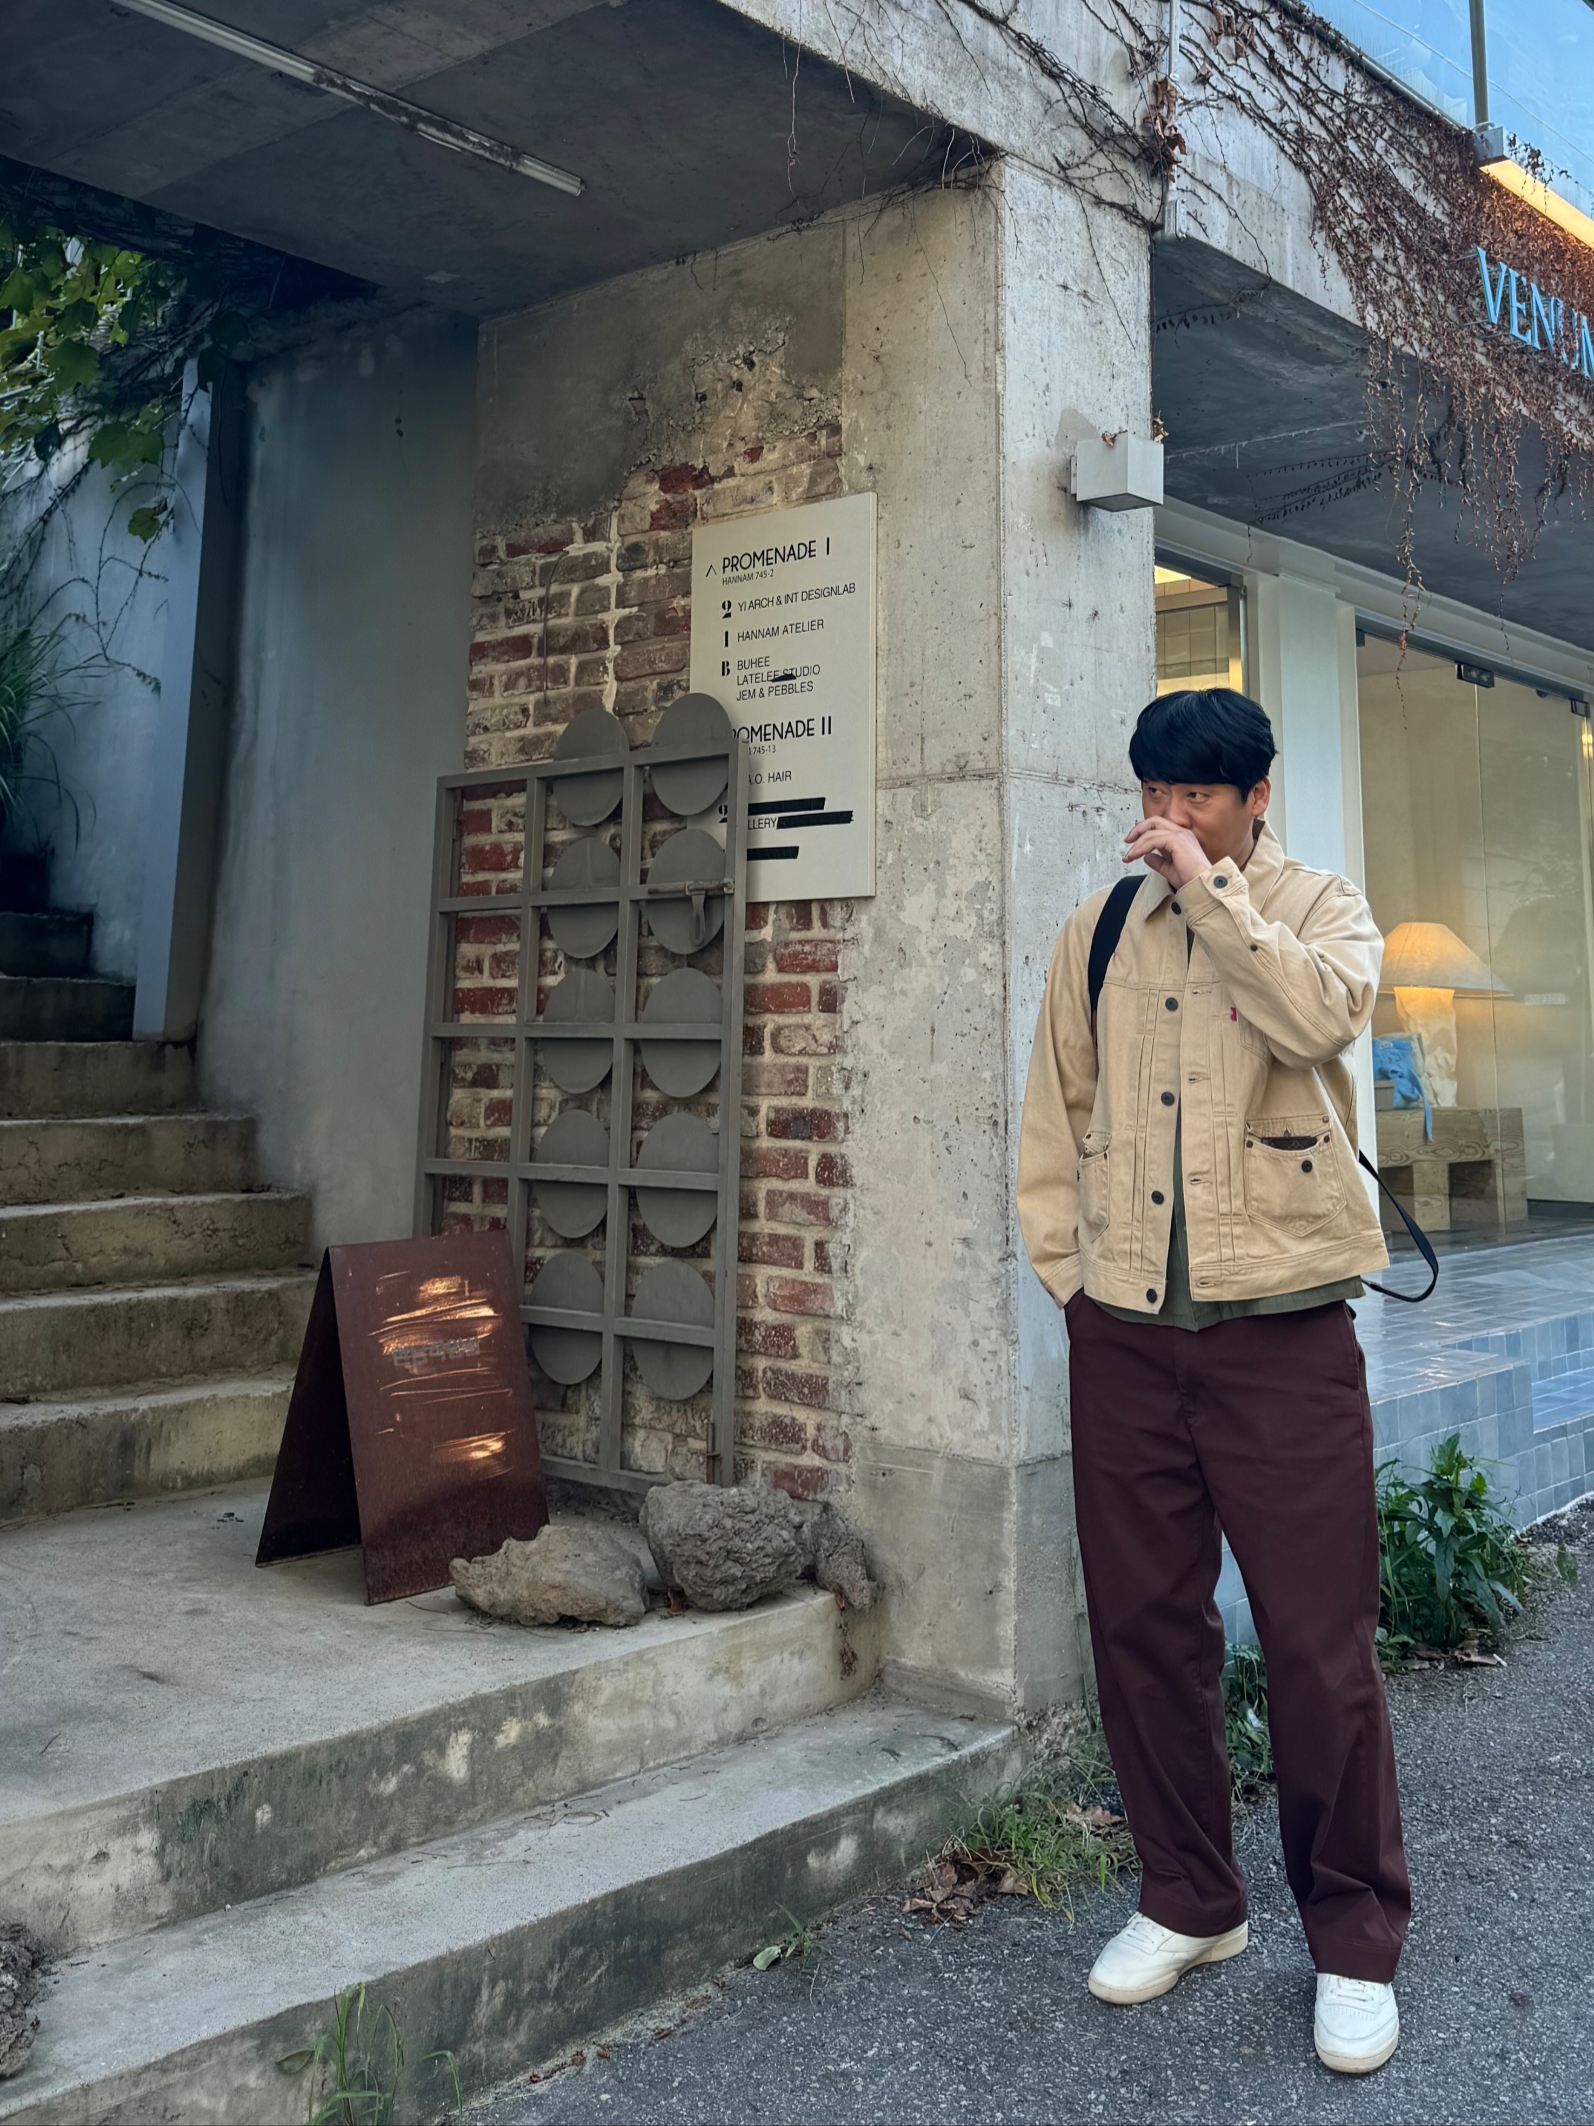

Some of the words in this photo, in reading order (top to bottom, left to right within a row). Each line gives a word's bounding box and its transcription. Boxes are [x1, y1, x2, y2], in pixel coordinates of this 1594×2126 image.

[722, 539, 817, 574] PROMENADE
[722, 574, 754, 586] HANNAM
[755, 569, 774, 580] 745-2
[721, 600, 732, 619] 2
[748, 596, 774, 611] ARCH
[775, 595, 783, 605] &
[784, 592, 799, 605] INT
[801, 582, 856, 602] DESIGNLAB
[737, 627, 780, 643] HANNAM
[782, 619, 825, 635] ATELIER
[721, 660, 731, 677] B
[737, 656, 771, 671] BUHEE
[736, 687, 756, 702] JEM
[759, 687, 765, 698] &
[768, 680, 814, 697] PEBBLES
[732, 718, 815, 744] OMENADE
[753, 745, 776, 755] 745-13
[768, 770, 792, 782] HAIR
[748, 817, 777, 830] LLERY
